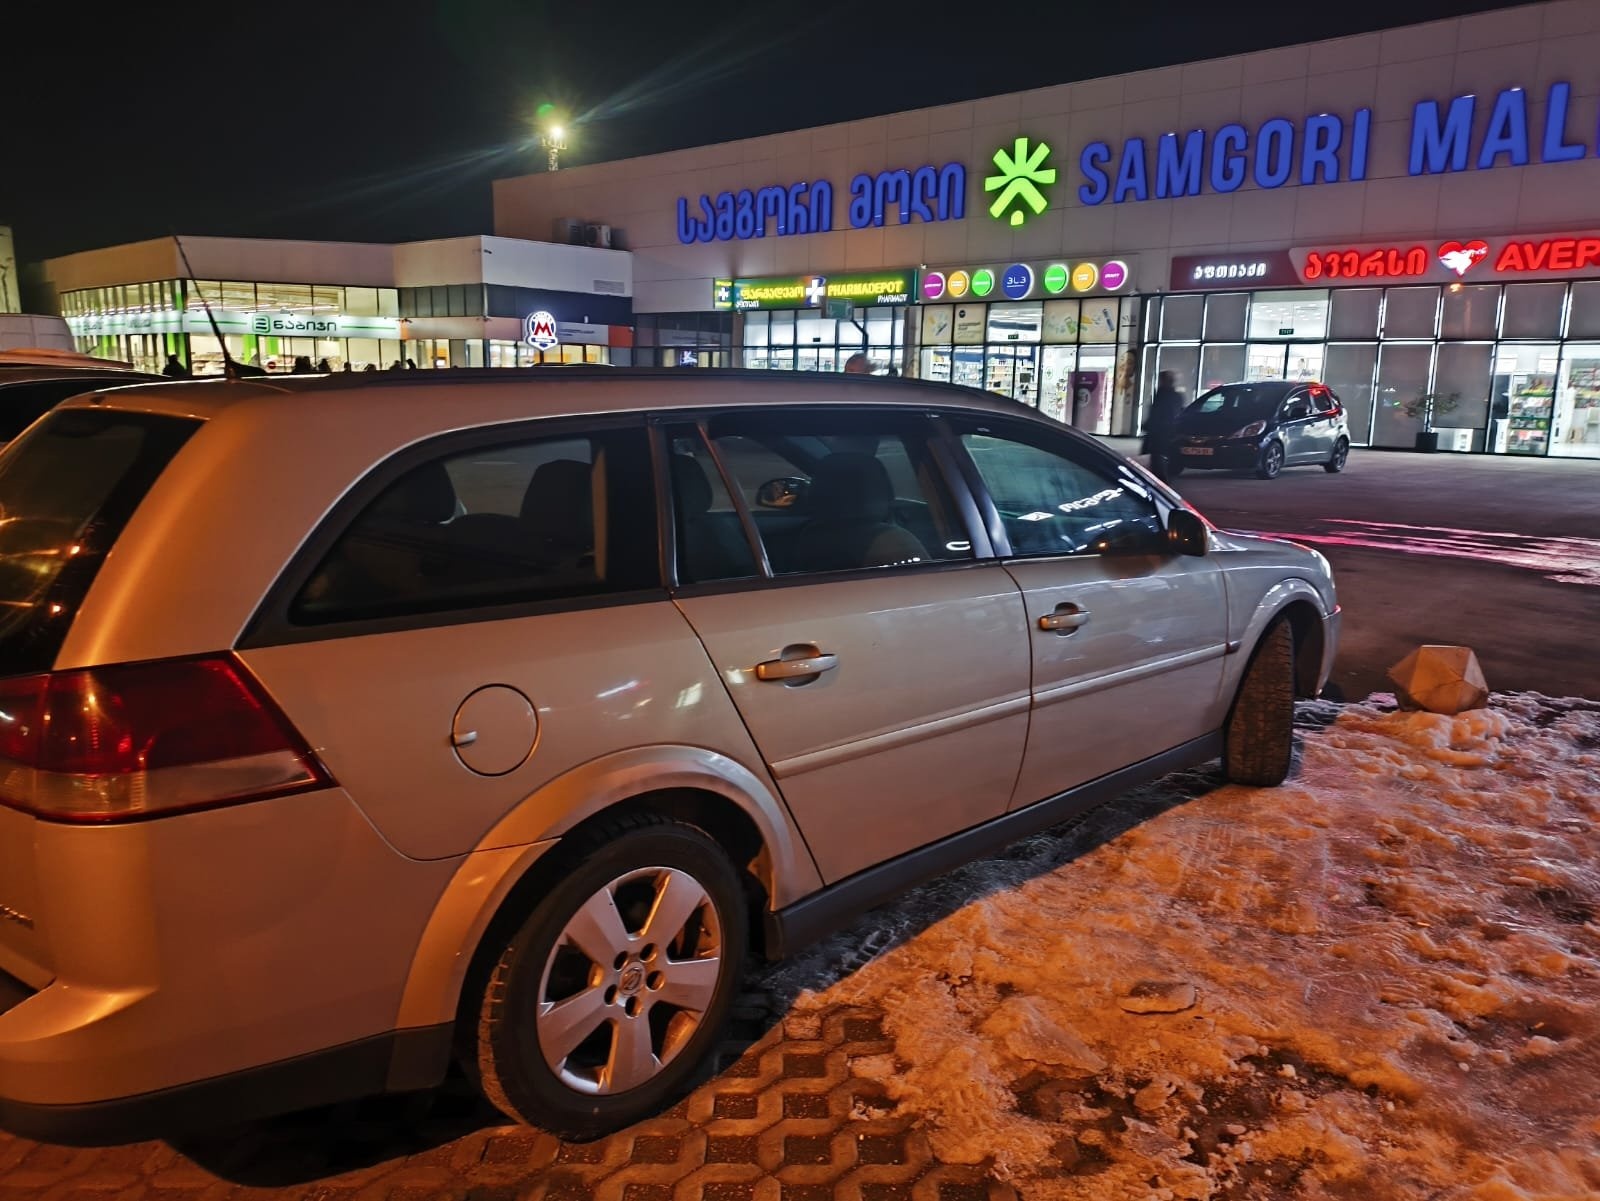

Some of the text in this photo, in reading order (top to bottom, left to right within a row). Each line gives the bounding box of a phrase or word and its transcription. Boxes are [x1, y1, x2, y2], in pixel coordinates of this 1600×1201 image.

[1078, 81, 1600, 206] SAMGORI MAL
[677, 162, 966, 245] სამგორი მოლი
[1193, 262, 1268, 280] აფთიაქი
[1304, 247, 1428, 280] ავერსი
[827, 280, 903, 297] PHARMADEPOT
